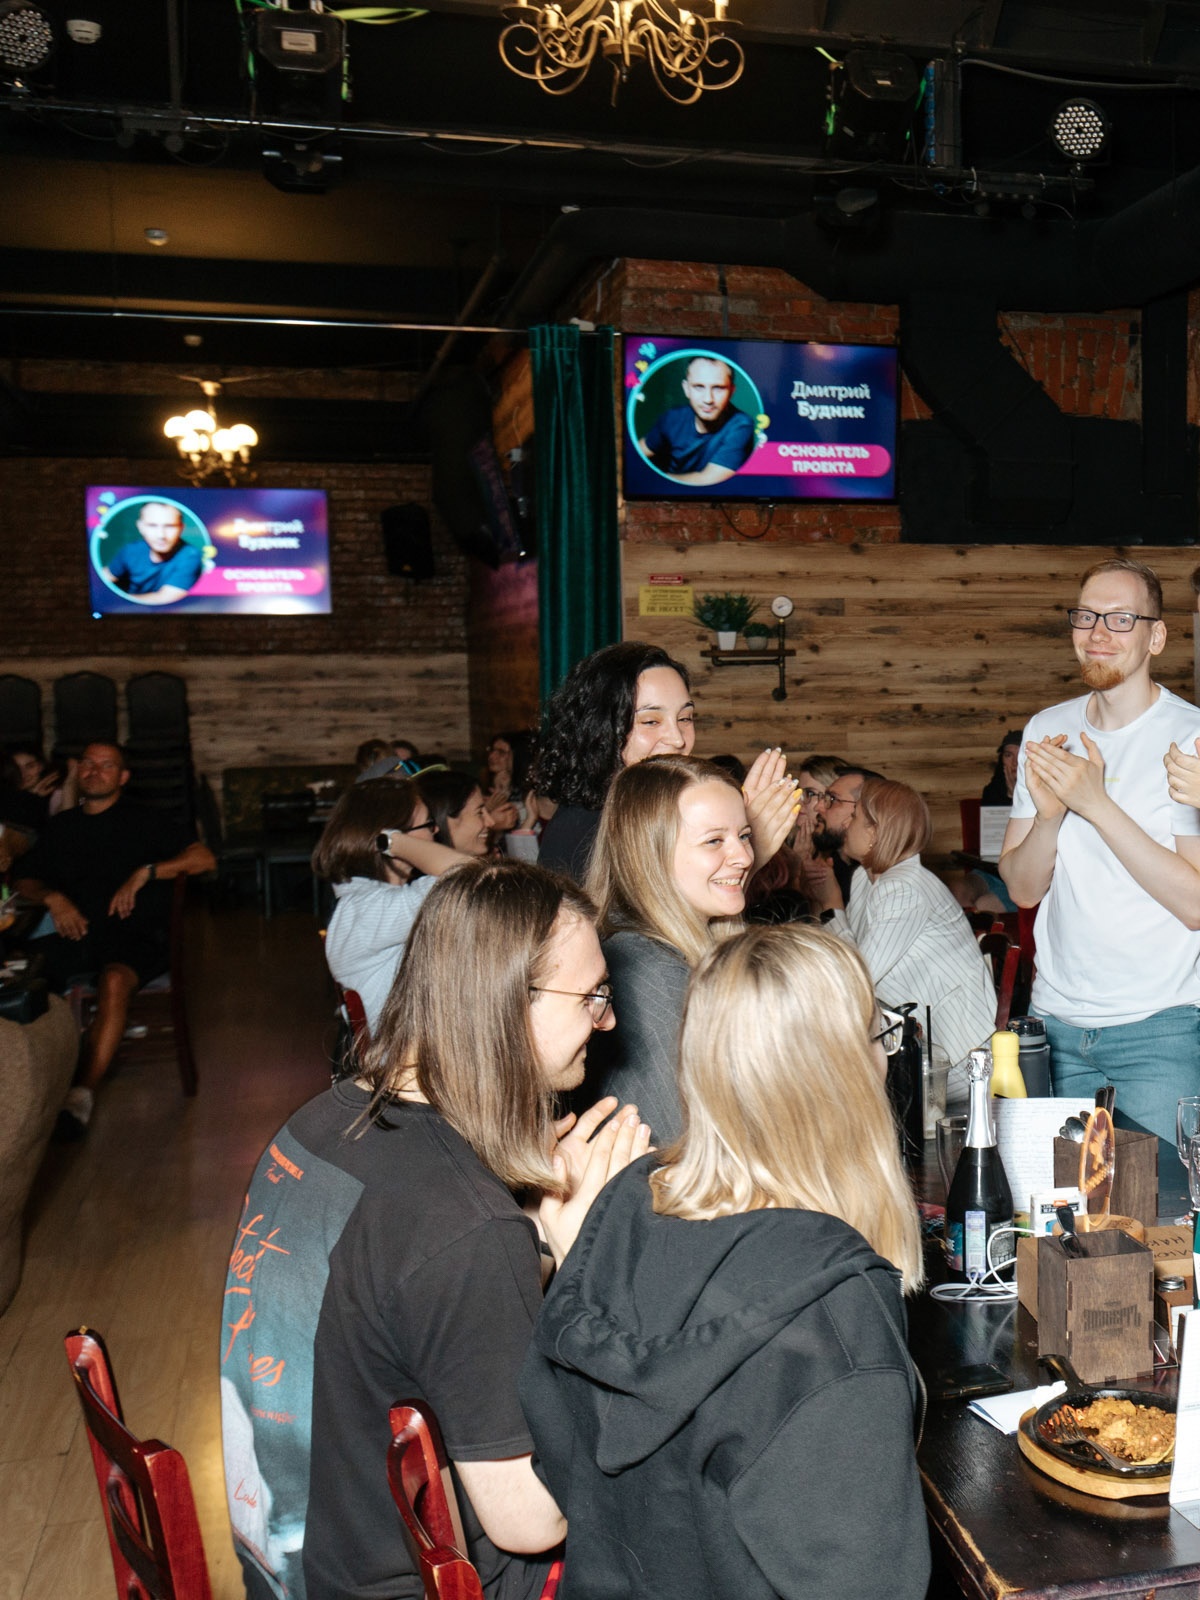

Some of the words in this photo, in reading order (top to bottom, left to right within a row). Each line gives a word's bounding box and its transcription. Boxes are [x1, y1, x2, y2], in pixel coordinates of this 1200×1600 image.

[790, 380, 872, 402] Дмитрий
[797, 401, 865, 420] Будник
[778, 444, 870, 459] ОСНОВАТЕЛЬ
[792, 459, 856, 474] ПРОЕКТА
